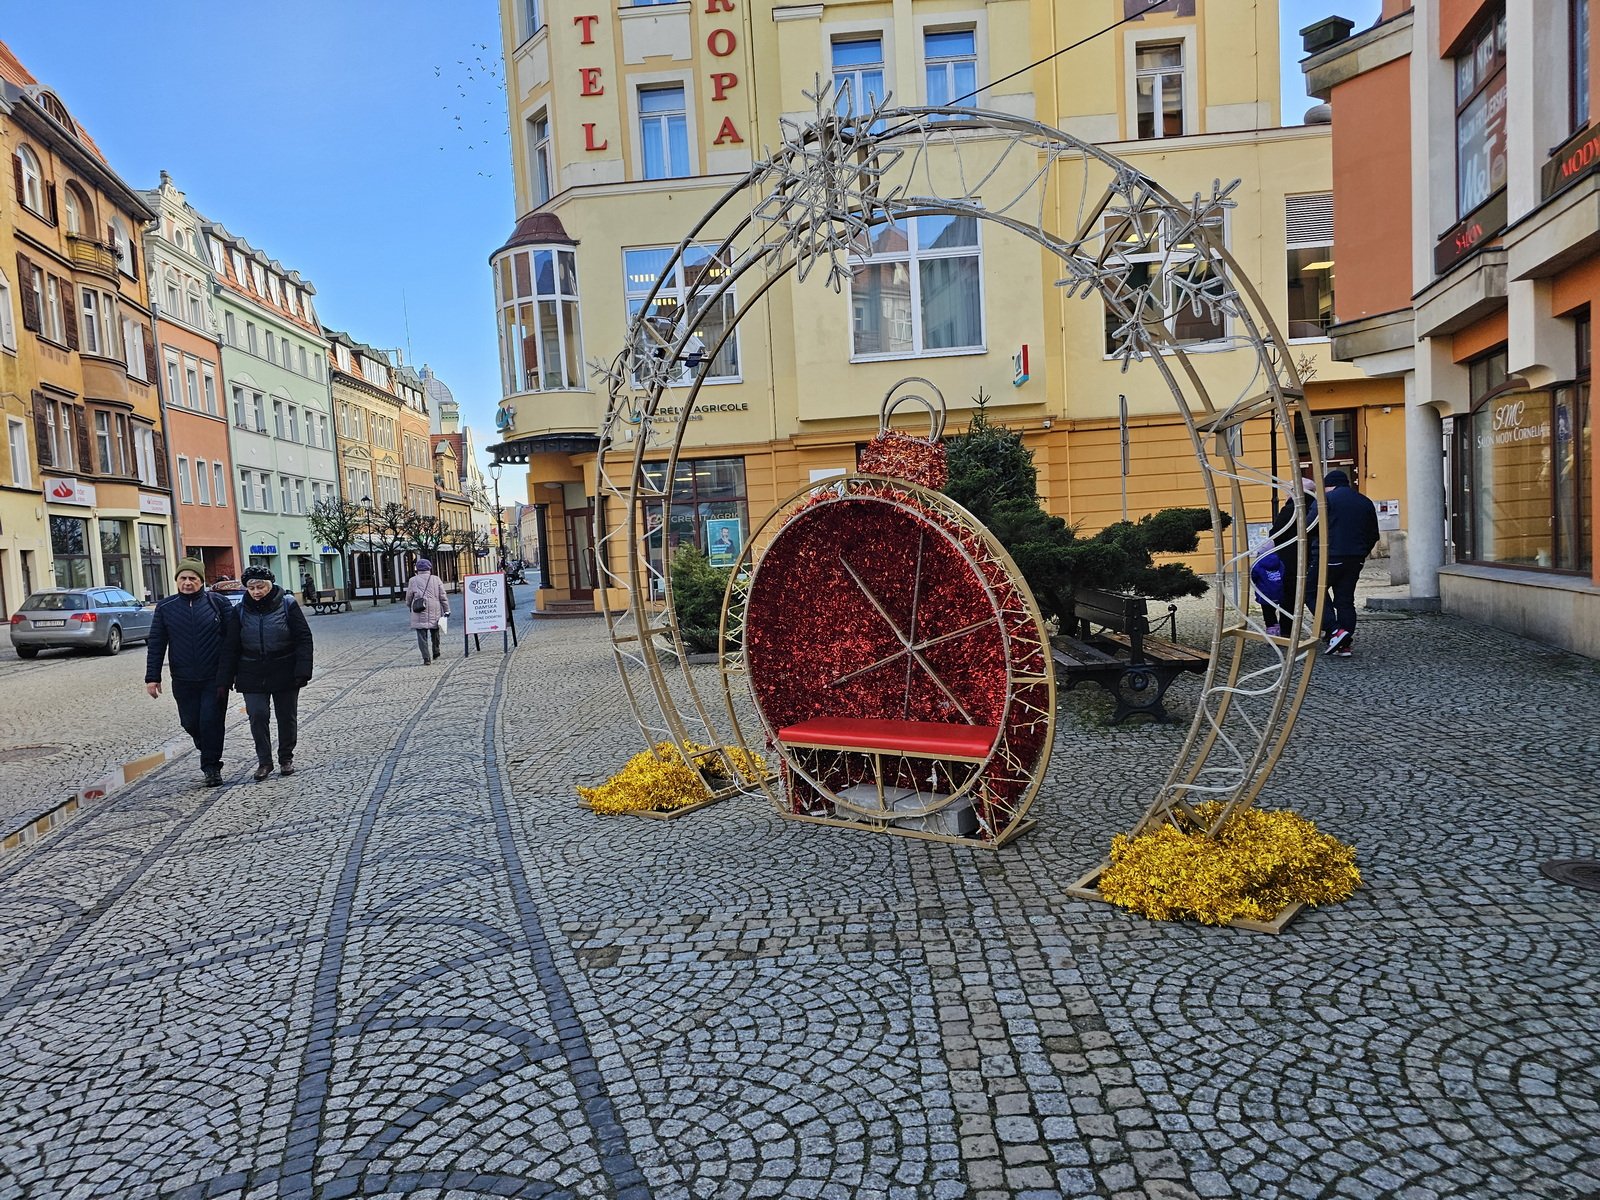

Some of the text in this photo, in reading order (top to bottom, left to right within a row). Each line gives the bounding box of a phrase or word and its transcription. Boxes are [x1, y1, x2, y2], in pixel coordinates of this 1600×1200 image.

[574, 15, 608, 151] TEL
[1562, 135, 1600, 177] MODY
[1455, 224, 1483, 254] SALON
[694, 403, 748, 413] AGRICOLE
[471, 580, 498, 589] Strefa
